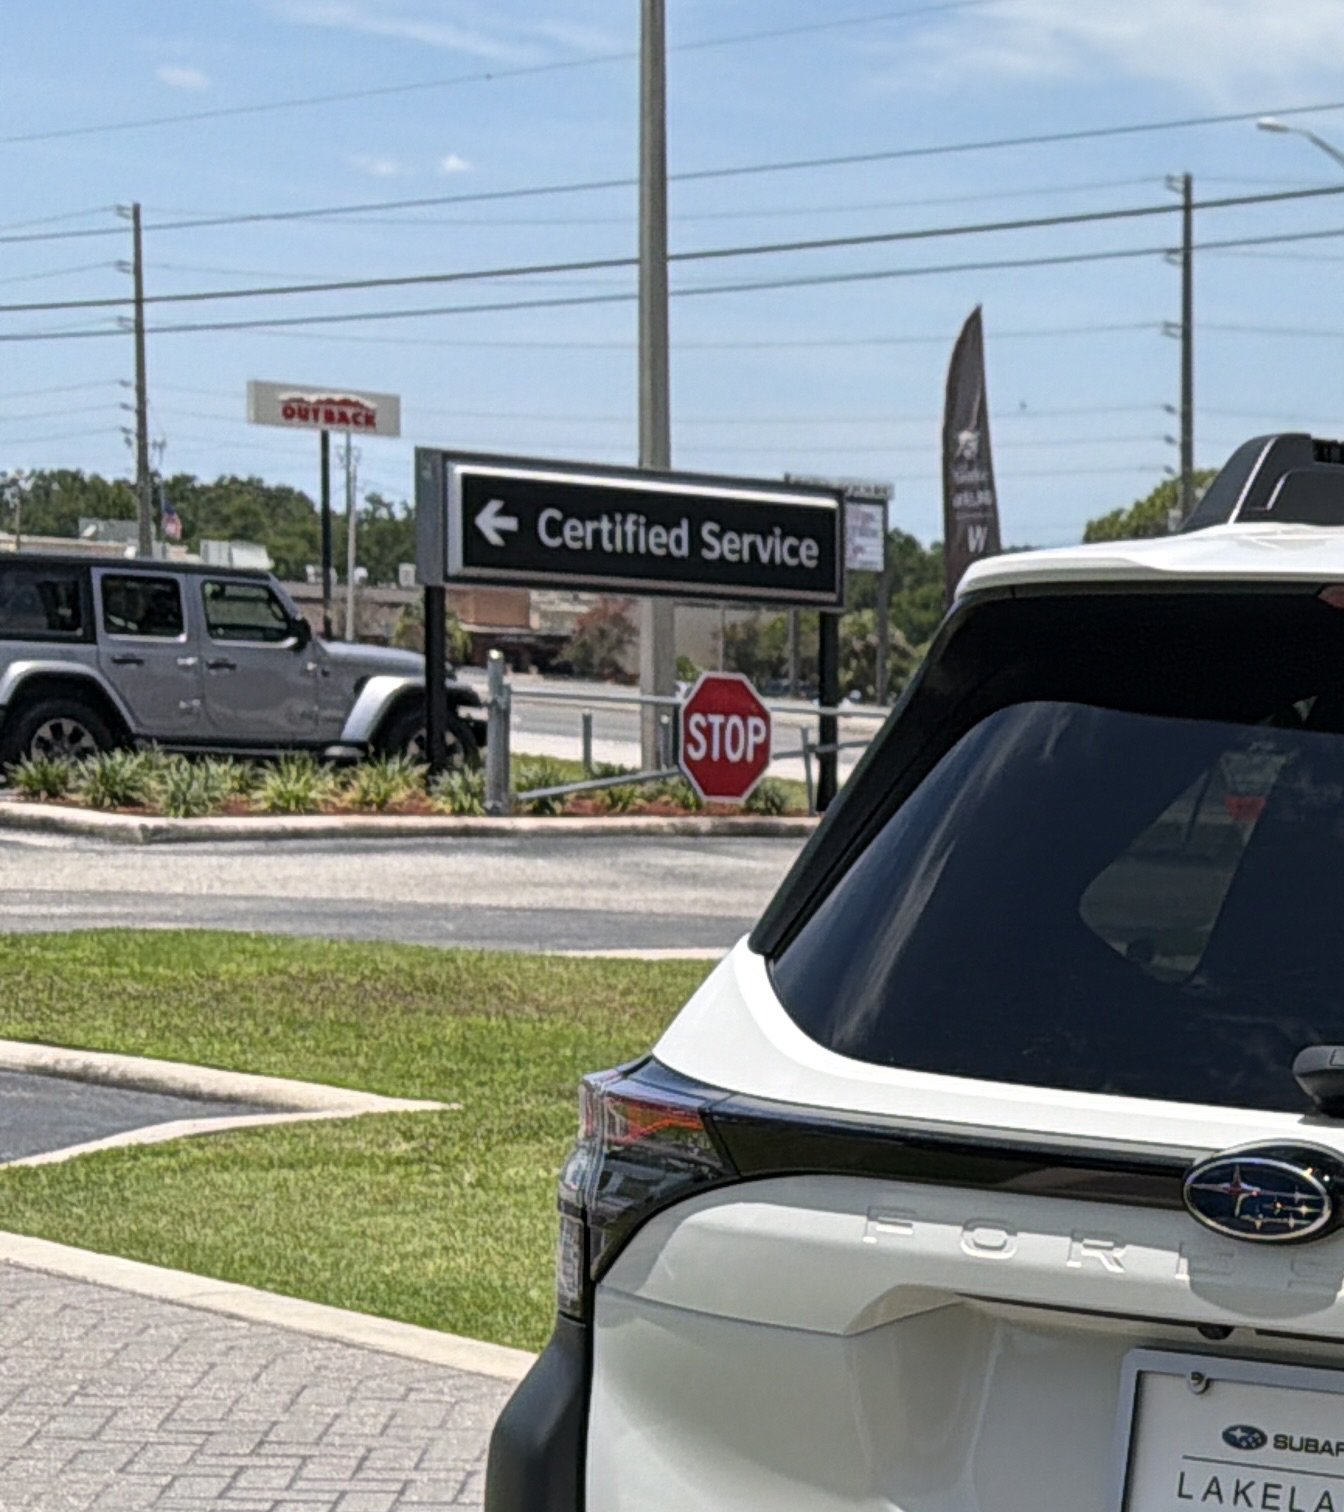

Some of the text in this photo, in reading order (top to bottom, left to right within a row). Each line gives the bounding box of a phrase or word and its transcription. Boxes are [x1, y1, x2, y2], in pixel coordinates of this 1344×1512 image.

[282, 404, 377, 428] OUTBACK
[538, 508, 690, 558] Certified
[701, 521, 820, 568] Service
[687, 713, 766, 763] STOP
